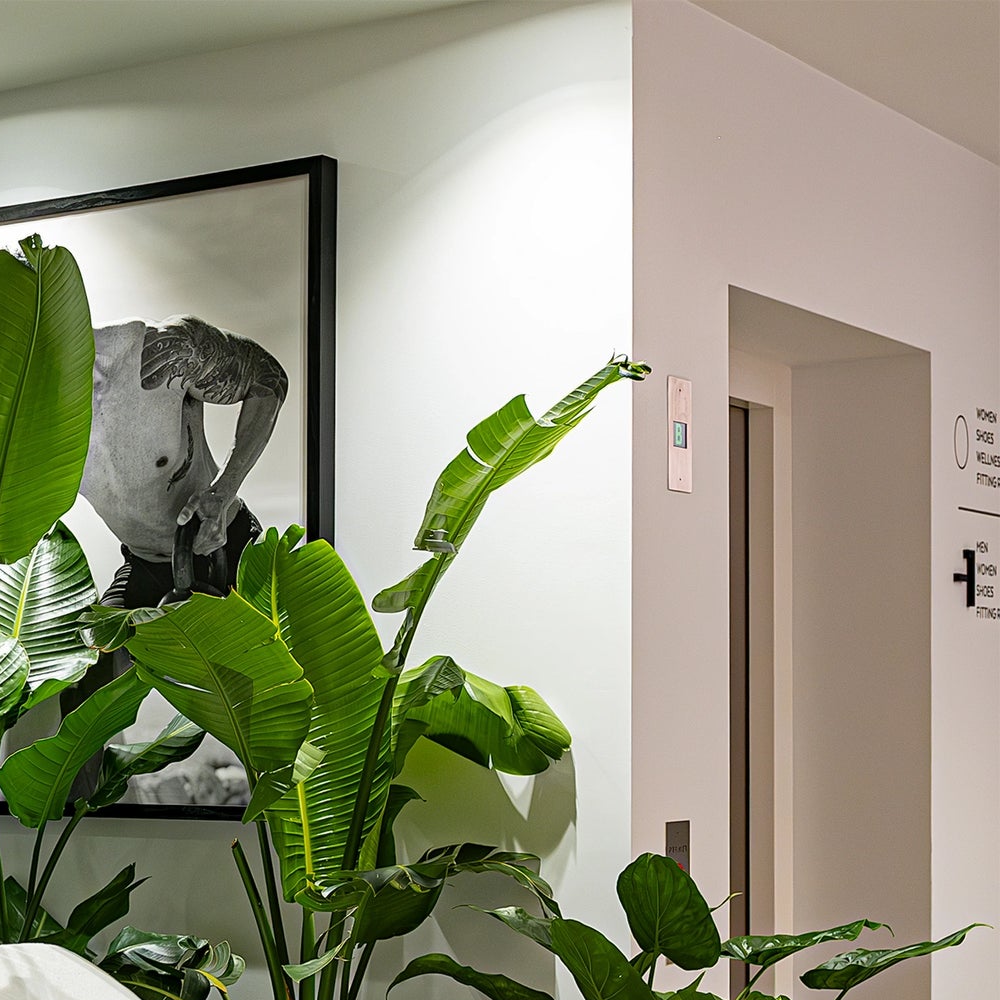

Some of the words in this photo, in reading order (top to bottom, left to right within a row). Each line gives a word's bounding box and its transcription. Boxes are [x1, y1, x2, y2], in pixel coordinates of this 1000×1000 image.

[976, 408, 997, 424] WOMEN
[976, 429, 994, 445] SHOES
[976, 472, 996, 489] FITTING
[976, 541, 988, 553] MEN
[976, 562, 997, 577] WOMEN
[976, 584, 994, 598] SHOES
[976, 606, 996, 620] FITTING
